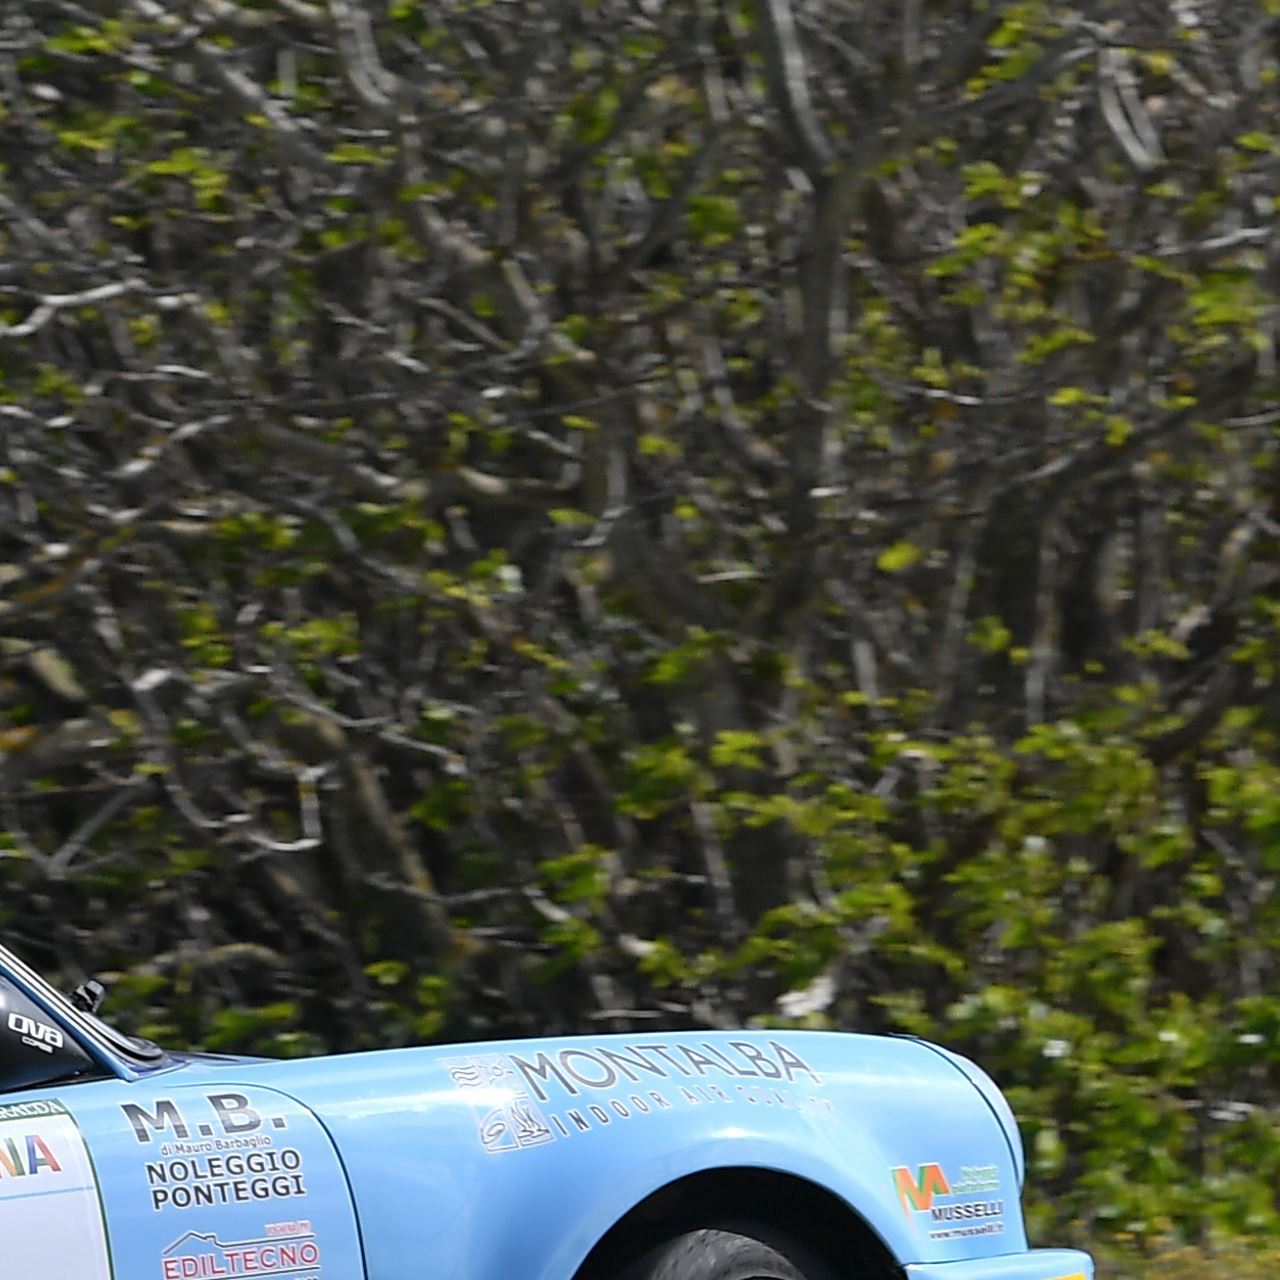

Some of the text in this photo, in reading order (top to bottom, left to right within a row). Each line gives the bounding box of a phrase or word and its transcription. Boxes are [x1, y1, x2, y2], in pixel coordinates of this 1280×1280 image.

[509, 1040, 822, 1101] MONTALBA
[120, 1093, 287, 1142] M.B.
[550, 1086, 671, 1136] INDOOR
[160, 1134, 272, 1156] di Mauro Barbaglio
[146, 1149, 301, 1185] NOLEGGIO
[151, 1174, 306, 1210] PONTEGGI
[931, 1200, 1004, 1222] MUSSELLI
[163, 1243, 319, 1280] EDILTECNO
